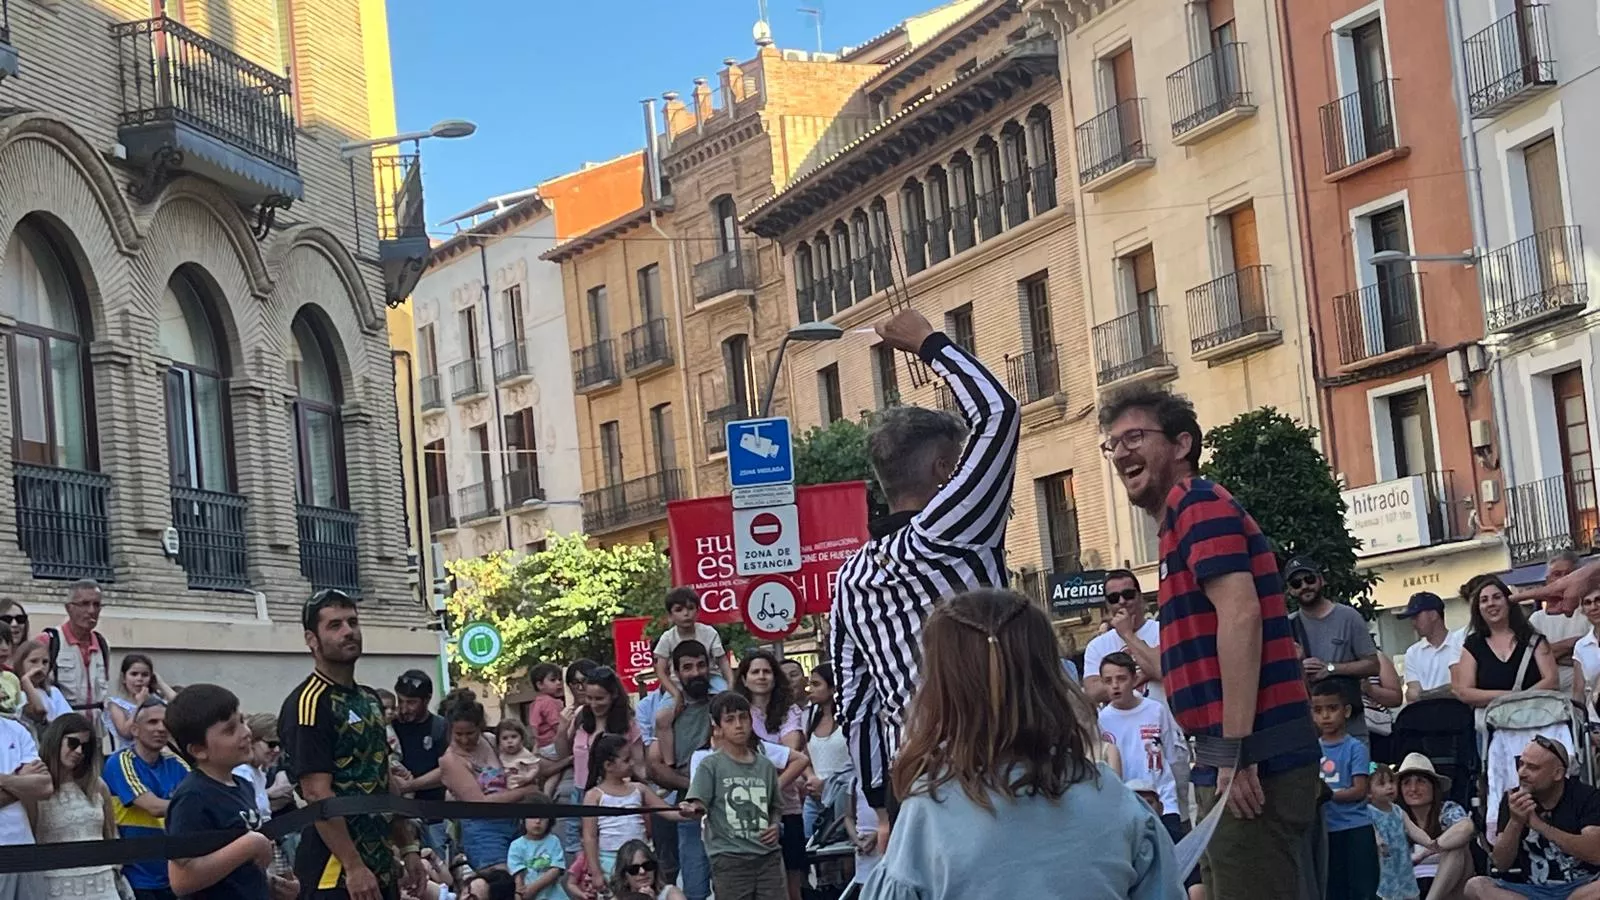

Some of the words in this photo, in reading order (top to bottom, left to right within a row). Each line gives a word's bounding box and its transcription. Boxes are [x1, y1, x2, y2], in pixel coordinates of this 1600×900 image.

[1353, 487, 1409, 515] hitradio
[744, 549, 772, 559] ZONA
[777, 547, 790, 557] DE
[819, 551, 829, 561] DE
[697, 554, 735, 580] es
[743, 558, 793, 570] ESTANCIA
[1053, 583, 1104, 599] Arenas
[700, 588, 739, 613] ca
